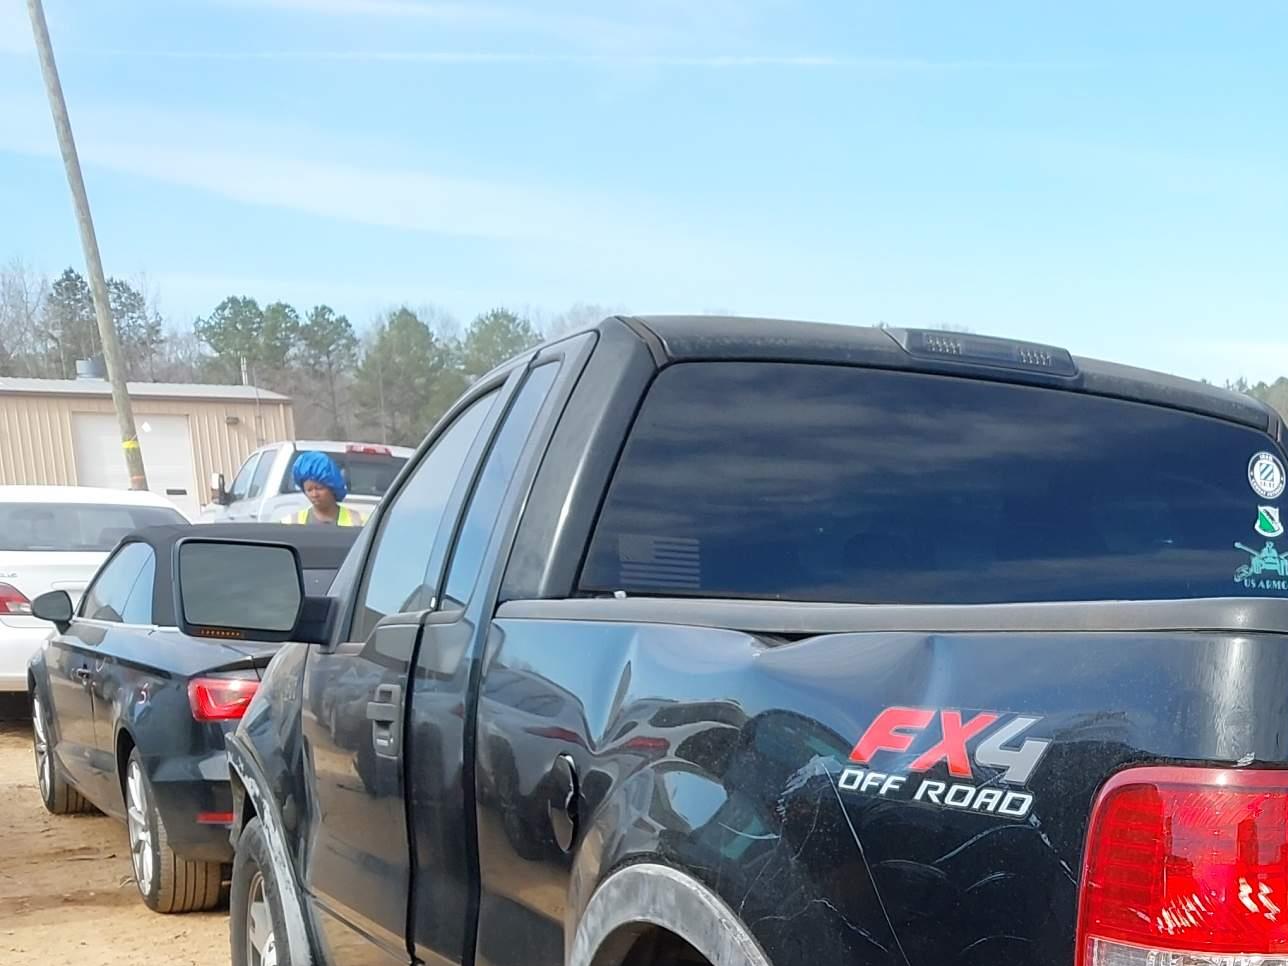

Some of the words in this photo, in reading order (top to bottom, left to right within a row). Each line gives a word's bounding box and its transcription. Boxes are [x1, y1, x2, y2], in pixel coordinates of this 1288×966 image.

[849, 705, 1053, 785] FX4
[838, 768, 906, 796] OFF
[913, 780, 1033, 816] ROAD
